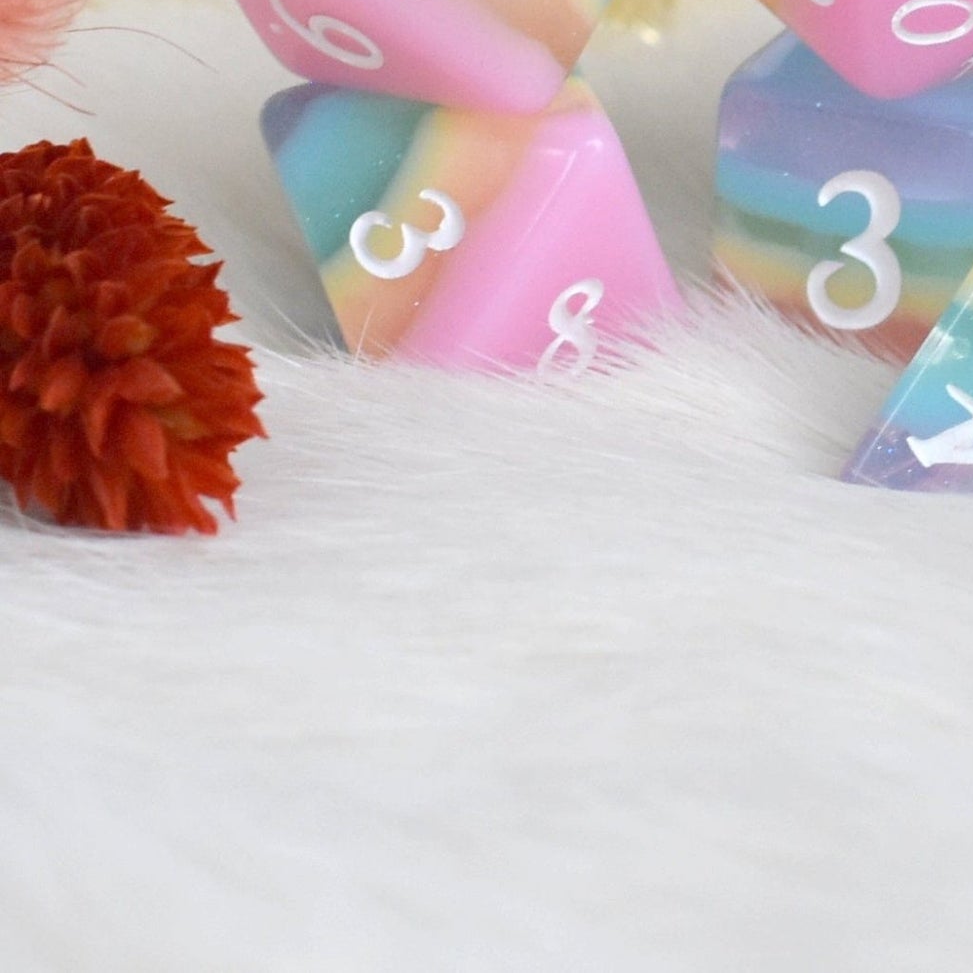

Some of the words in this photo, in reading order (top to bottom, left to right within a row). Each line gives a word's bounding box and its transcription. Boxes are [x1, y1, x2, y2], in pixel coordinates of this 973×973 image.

[349, 187, 466, 280] 3
[806, 169, 902, 331] 3
[537, 277, 605, 377] 8
